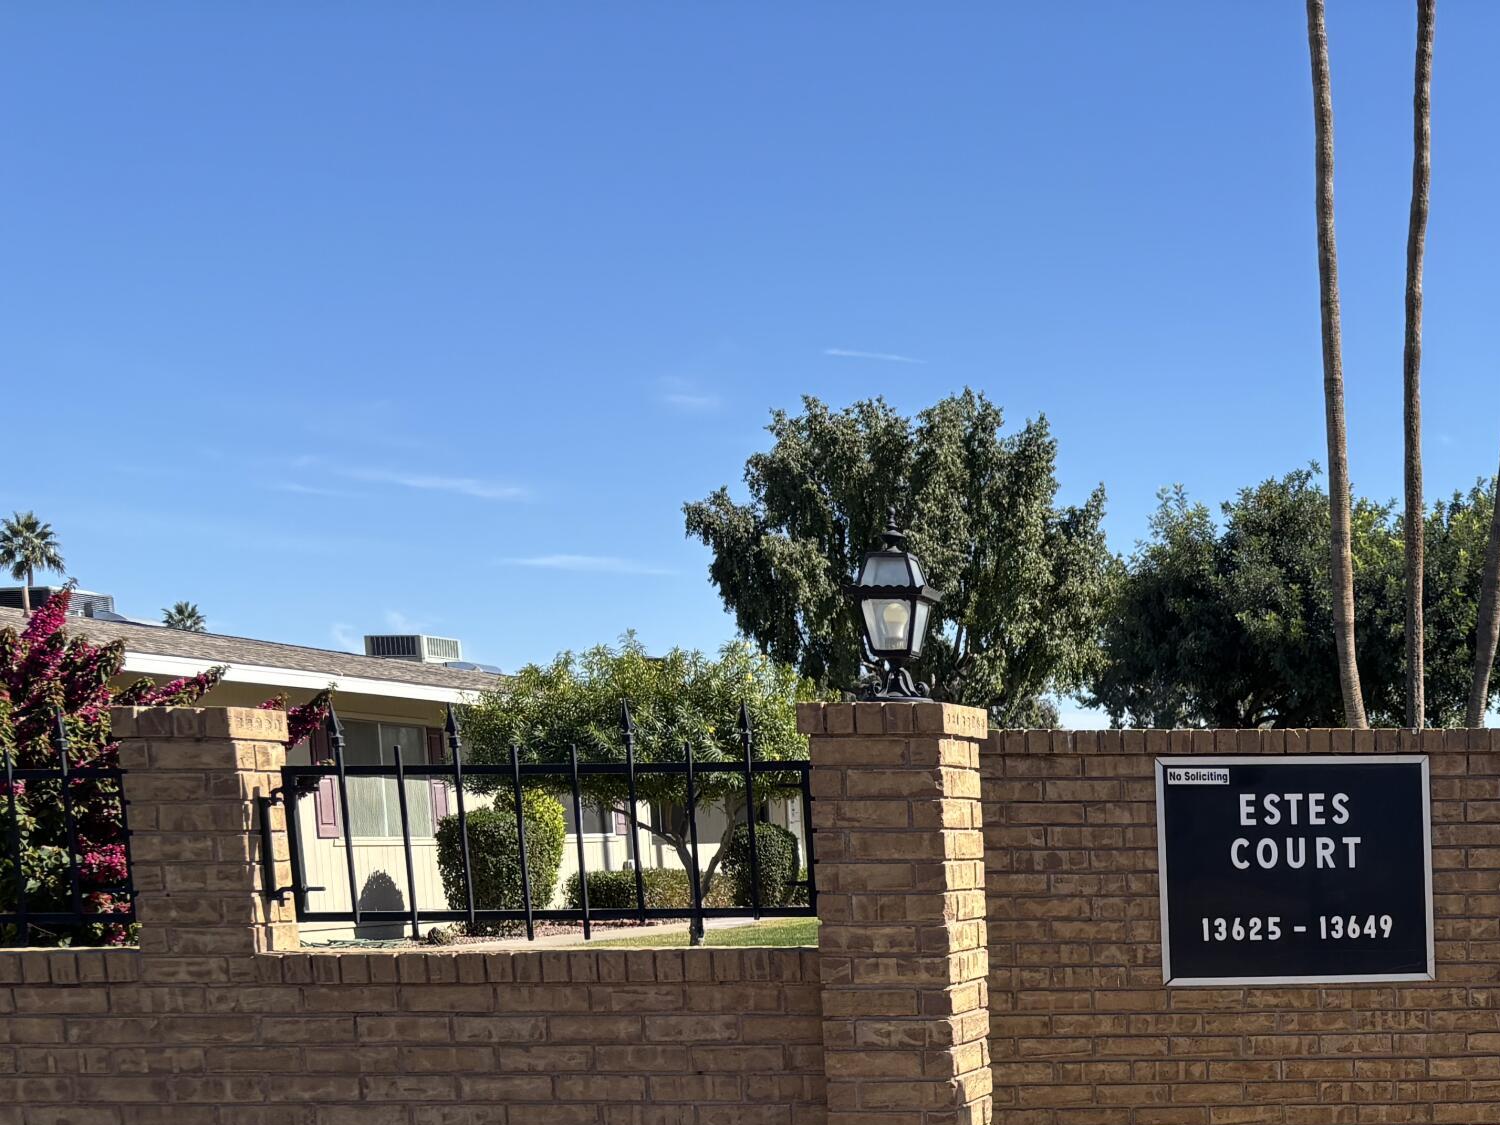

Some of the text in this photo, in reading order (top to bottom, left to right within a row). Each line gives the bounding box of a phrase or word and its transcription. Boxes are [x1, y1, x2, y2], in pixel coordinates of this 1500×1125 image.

[1169, 771, 1228, 783] No Soliciting
[1239, 793, 1350, 826] ESTES
[1230, 836, 1361, 870] COURT
[1201, 917, 1282, 942] 13625
[1319, 914, 1393, 940] 13649
